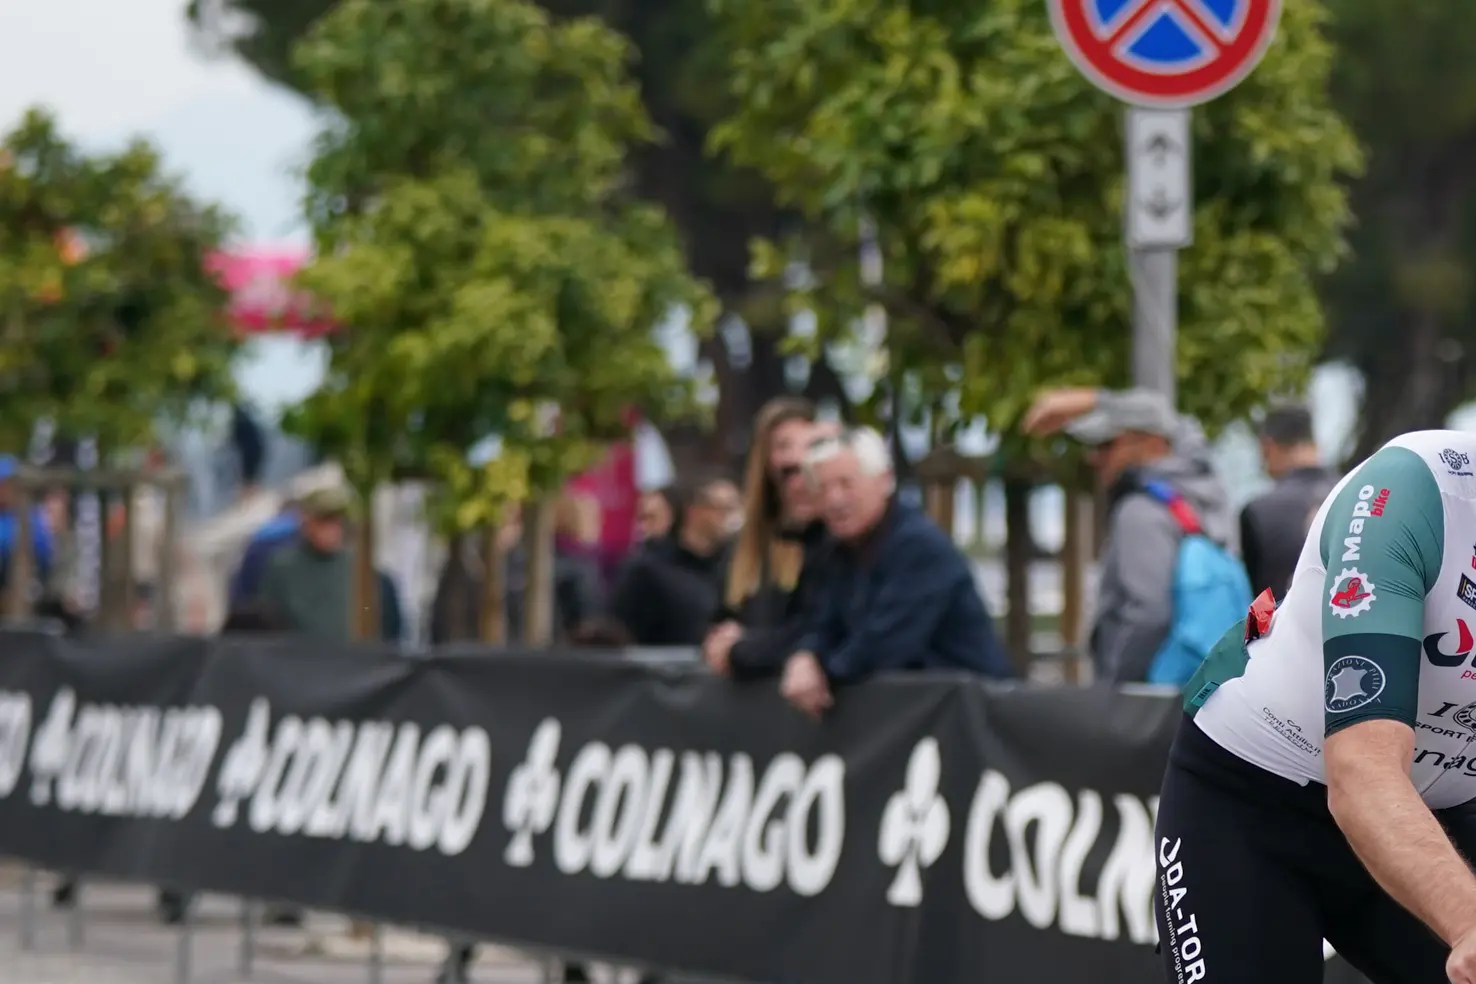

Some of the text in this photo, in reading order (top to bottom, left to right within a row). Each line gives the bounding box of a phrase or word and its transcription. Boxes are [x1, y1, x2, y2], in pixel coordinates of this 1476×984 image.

[1342, 484, 1374, 561] Mapo
[1370, 488, 1391, 517] bike
[1262, 707, 1322, 754] Conti Attilio.it
[250, 714, 490, 855] COLNAGO
[553, 741, 845, 896] COLNAGO
[964, 768, 1161, 945] COLN
[1160, 874, 1169, 906] people
[1165, 906, 1176, 947] forming
